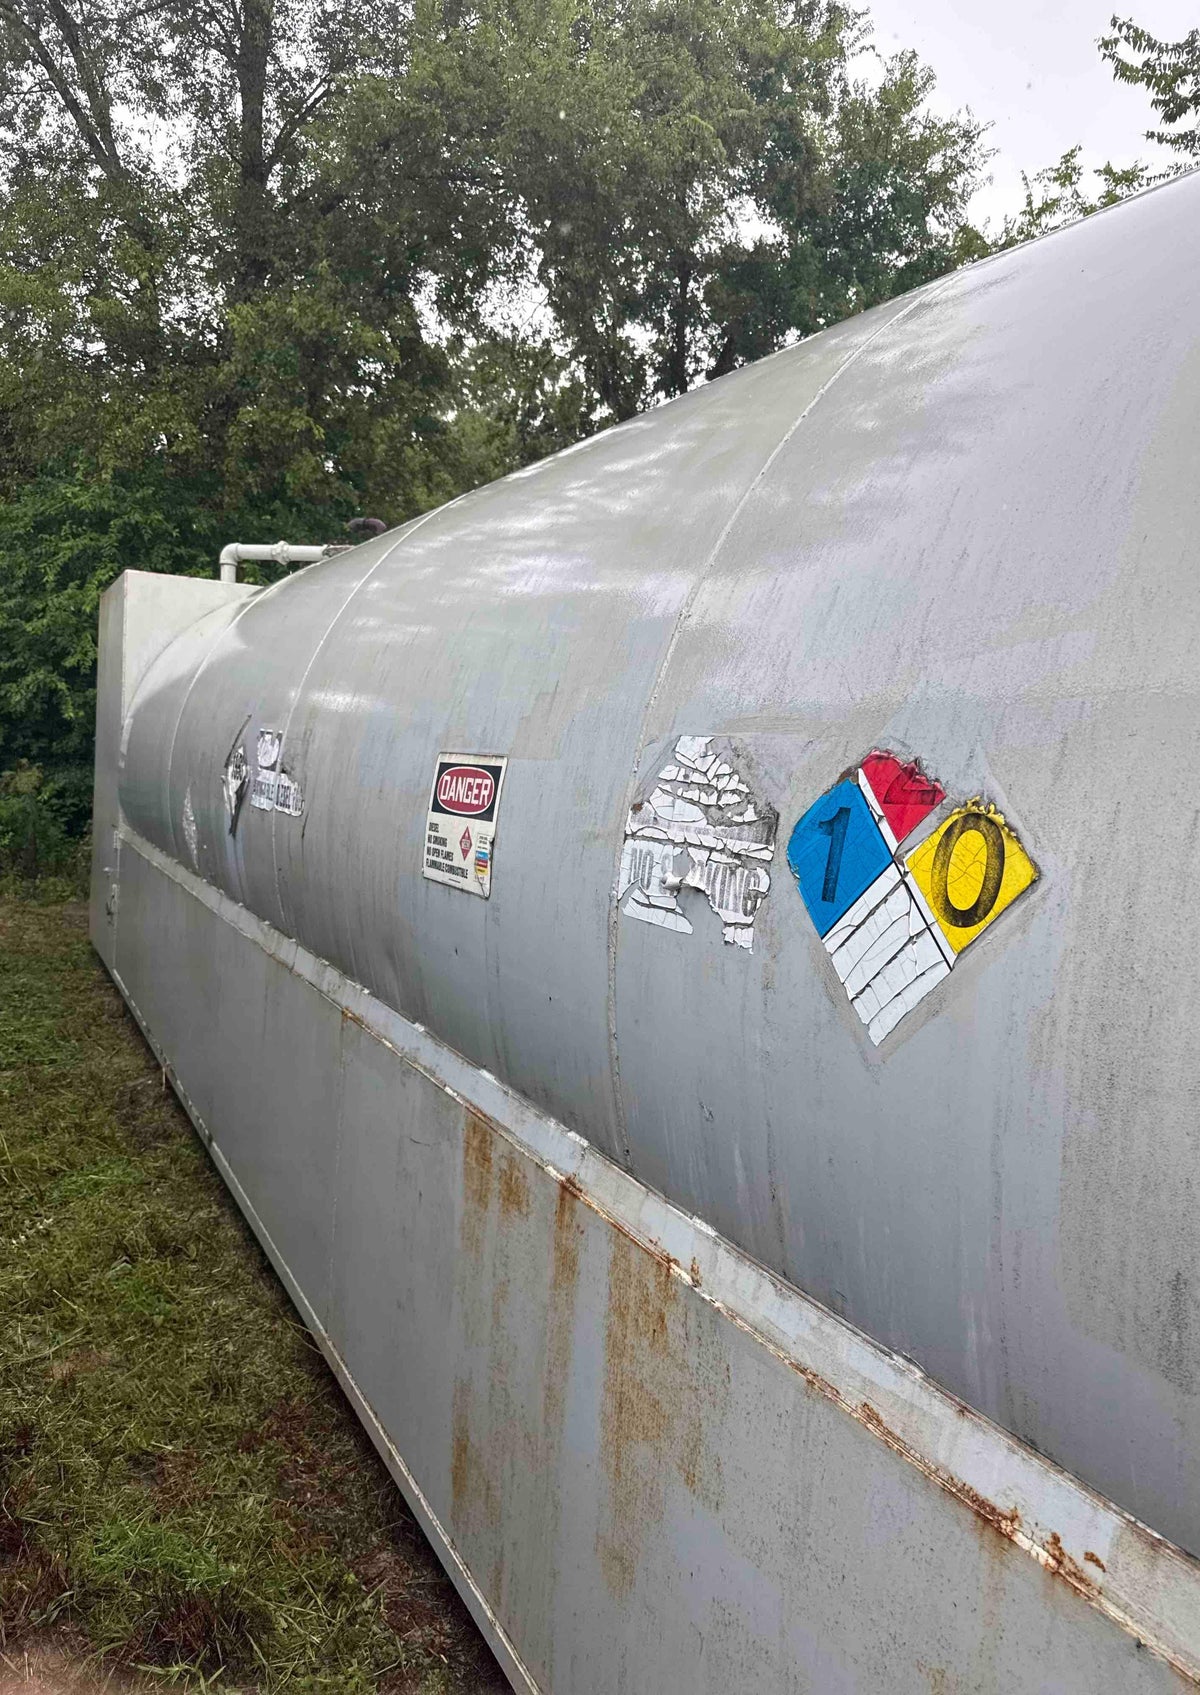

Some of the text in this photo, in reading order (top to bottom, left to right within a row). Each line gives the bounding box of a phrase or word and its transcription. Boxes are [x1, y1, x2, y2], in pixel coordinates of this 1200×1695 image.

[440, 775, 491, 806] DANGER
[427, 846, 453, 861] NO OPEN FLAMES
[428, 834, 447, 847] NO SMOKING
[819, 806, 851, 904] 1
[426, 858, 444, 871] FLAMMABLE
[445, 864, 468, 879] COMBUSTIBLE
[628, 847, 654, 891] NO
[931, 812, 1006, 928] 0
